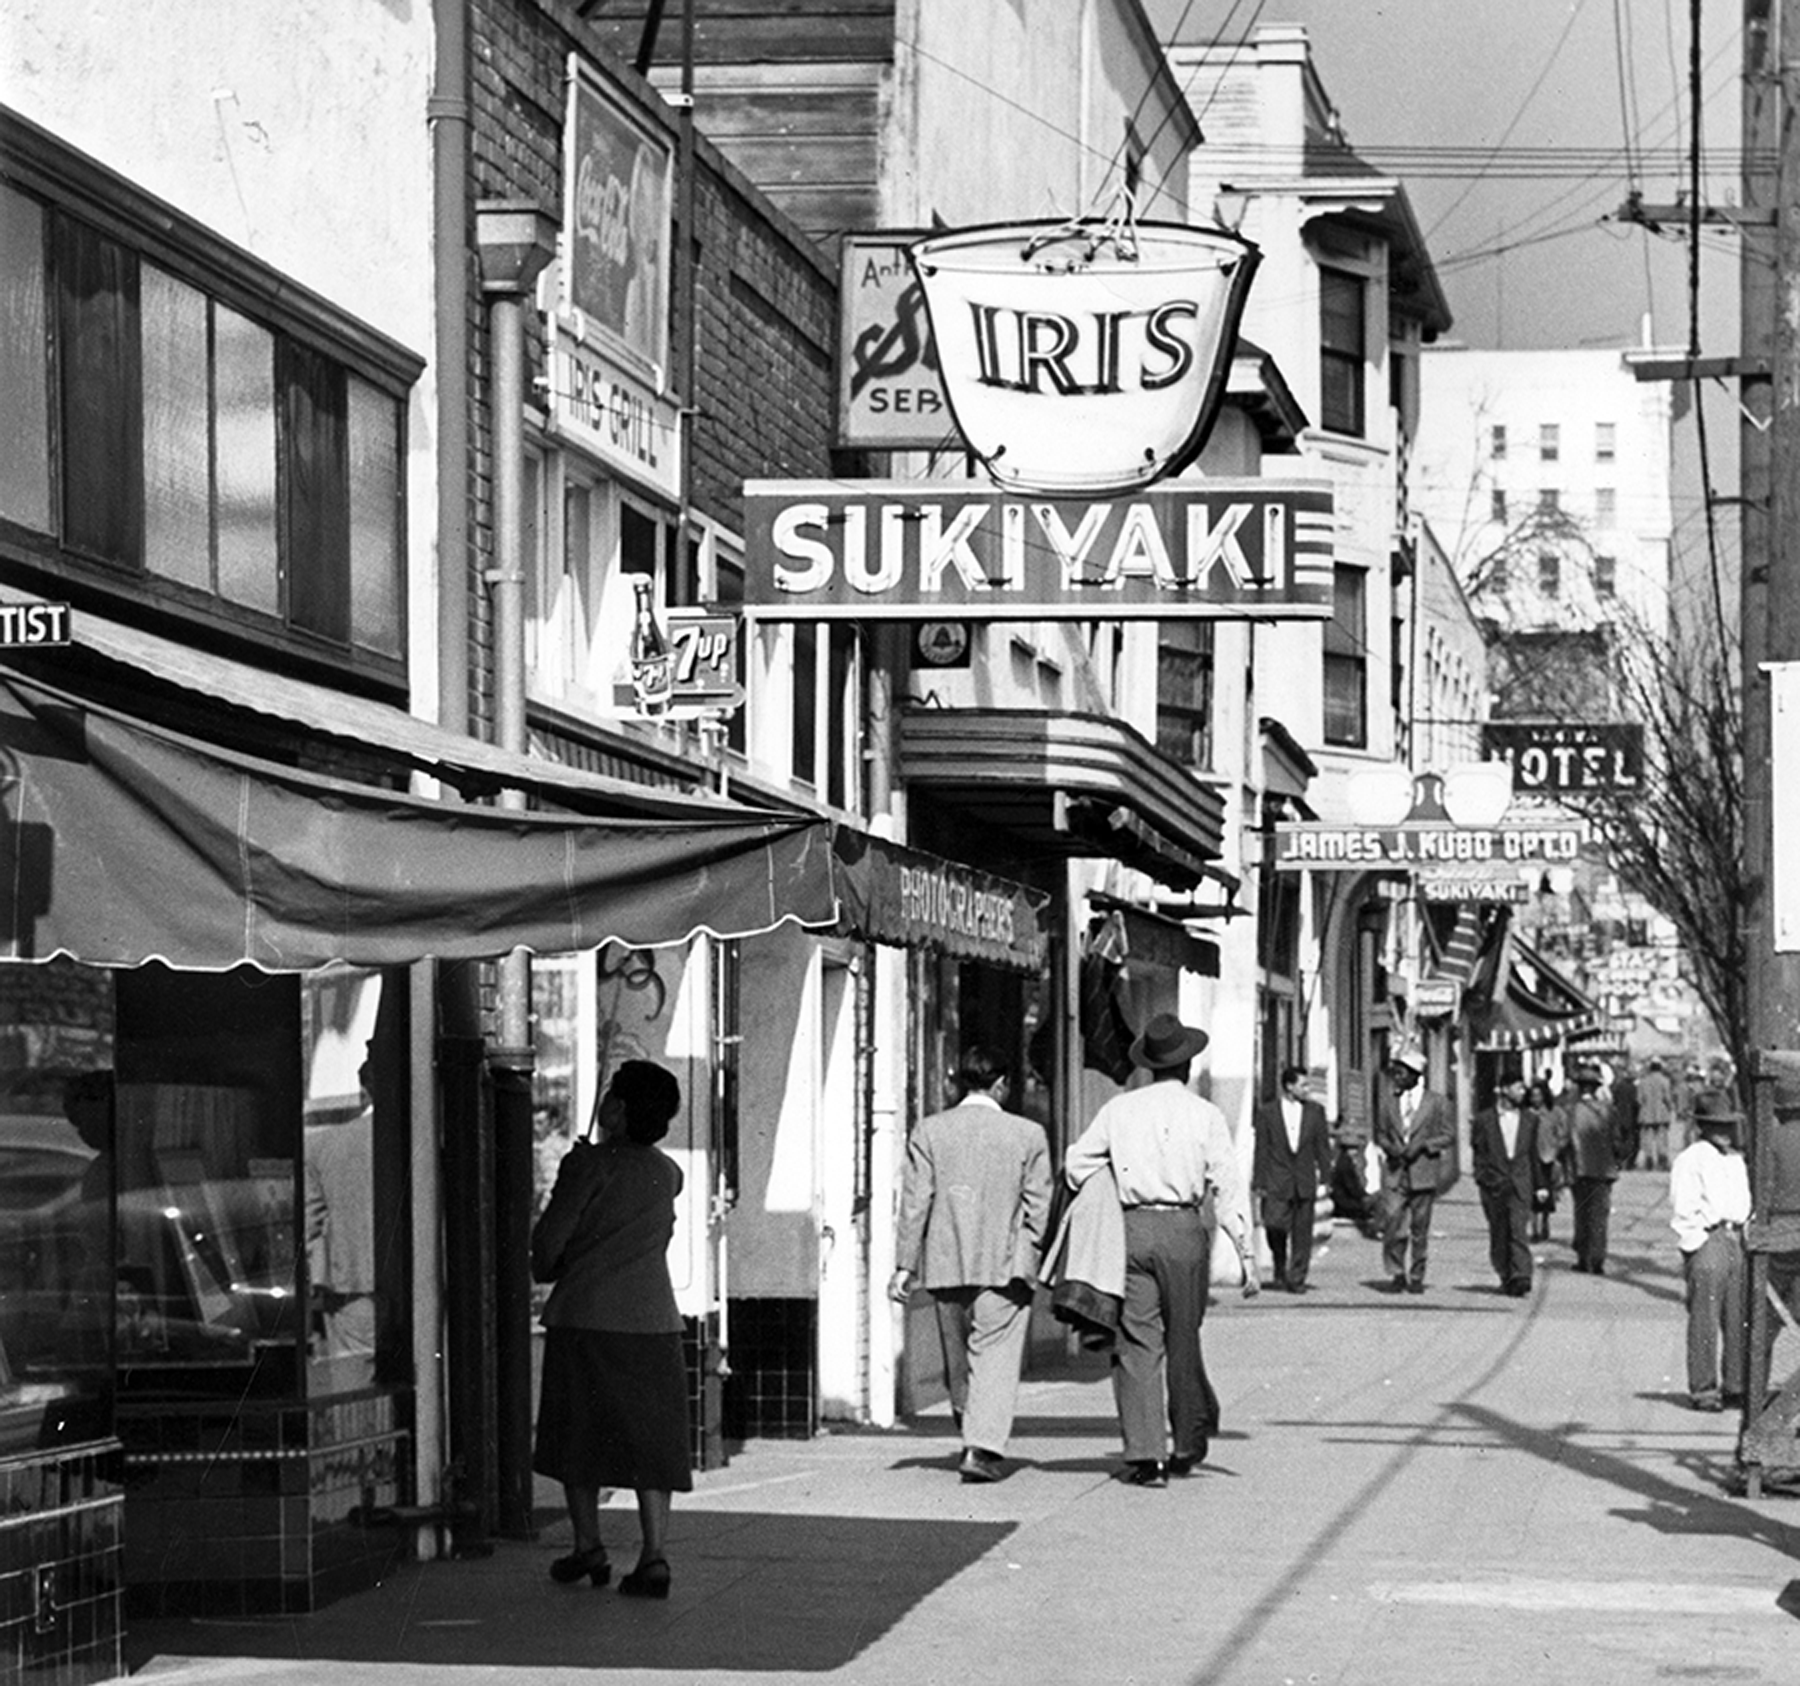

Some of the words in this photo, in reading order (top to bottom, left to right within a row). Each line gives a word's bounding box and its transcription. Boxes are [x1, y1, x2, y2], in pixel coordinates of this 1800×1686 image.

[966, 300, 1198, 397] IRIS
[568, 354, 603, 431] IRIS
[610, 383, 658, 469] GRILL
[771, 502, 1286, 595] SUKIYAKI
[0, 605, 66, 644] TIST
[1281, 831, 1381, 860] JAMES
[1387, 831, 1415, 860] J.
[1417, 831, 1493, 860] KUBO
[1423, 882, 1516, 901] SUKIYAKI
